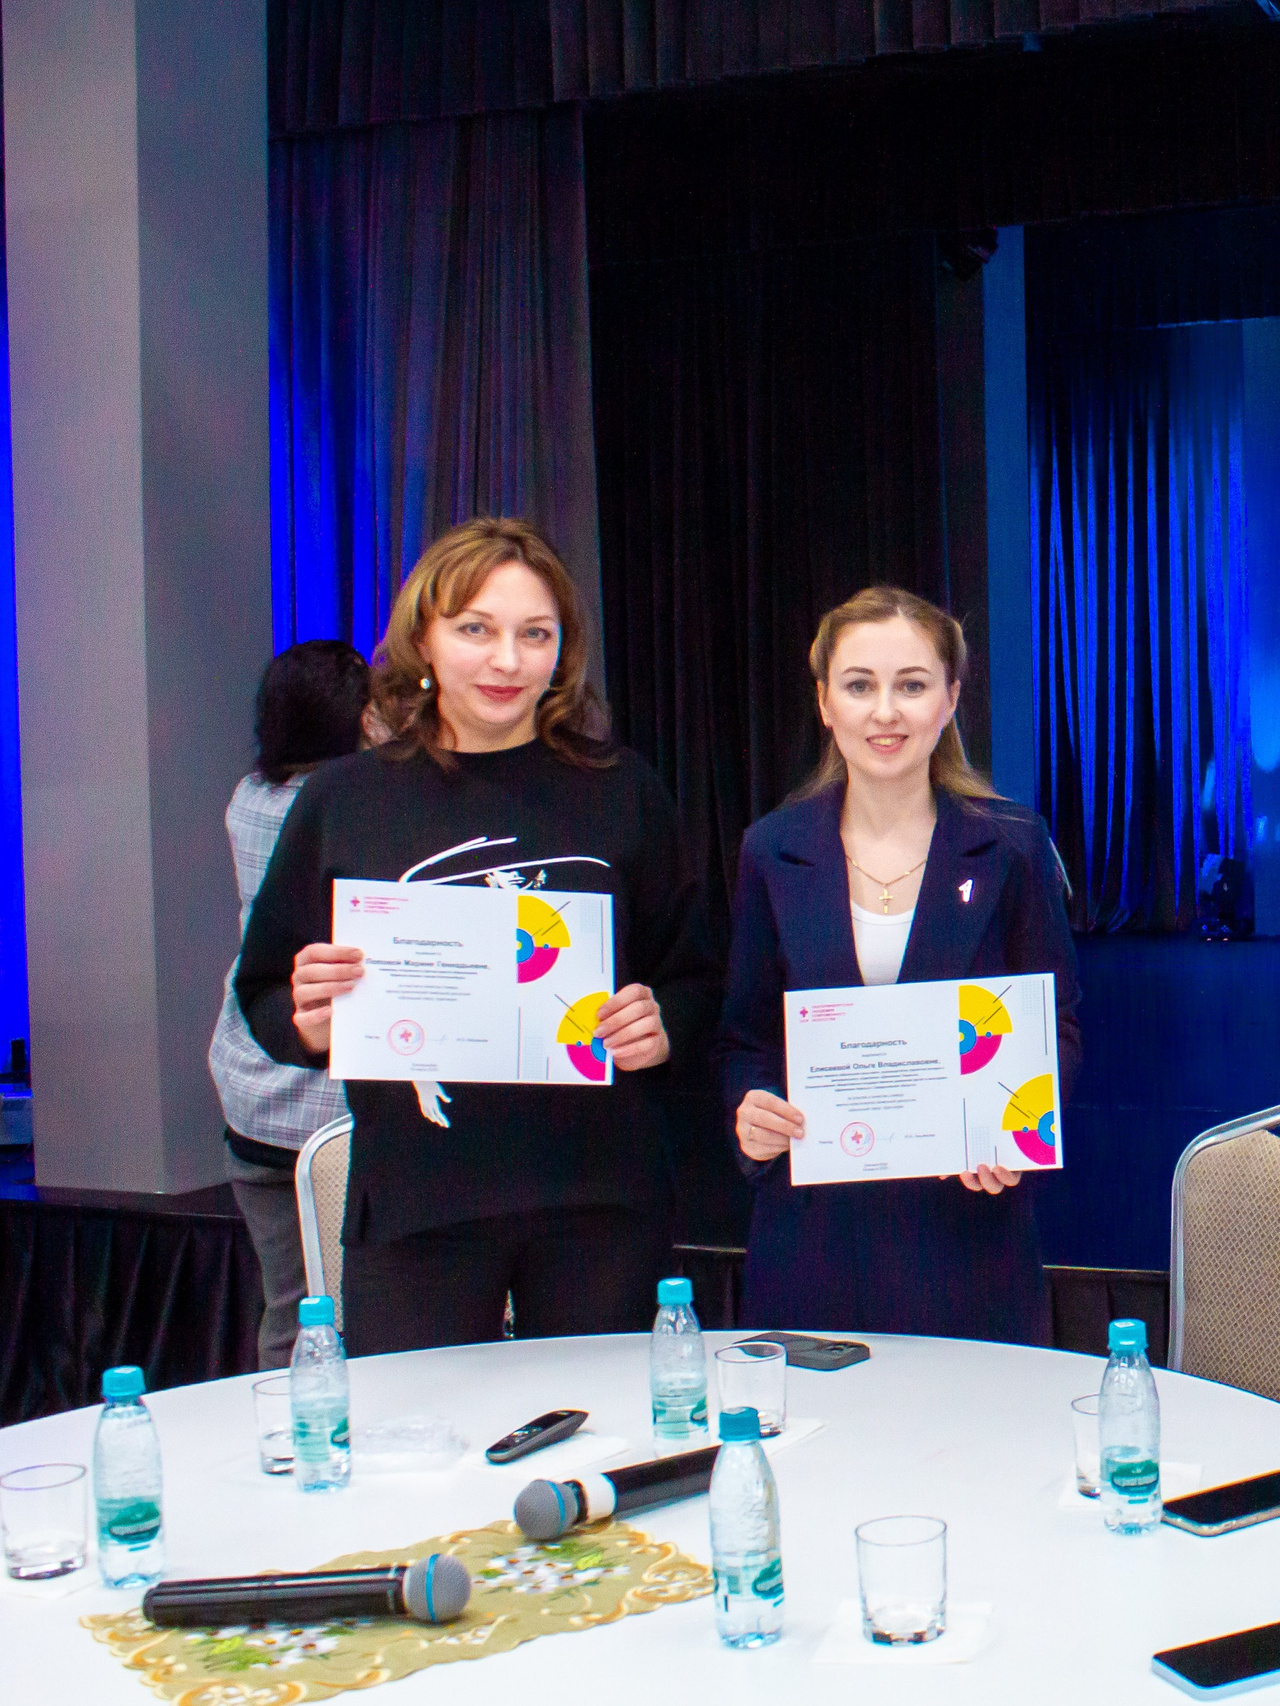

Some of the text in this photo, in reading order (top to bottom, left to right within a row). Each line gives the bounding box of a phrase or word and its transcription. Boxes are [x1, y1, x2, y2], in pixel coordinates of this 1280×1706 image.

[393, 936, 463, 947] Благодарность
[840, 1039, 907, 1050] Благодарность
[853, 1062, 876, 1070] Ольге
